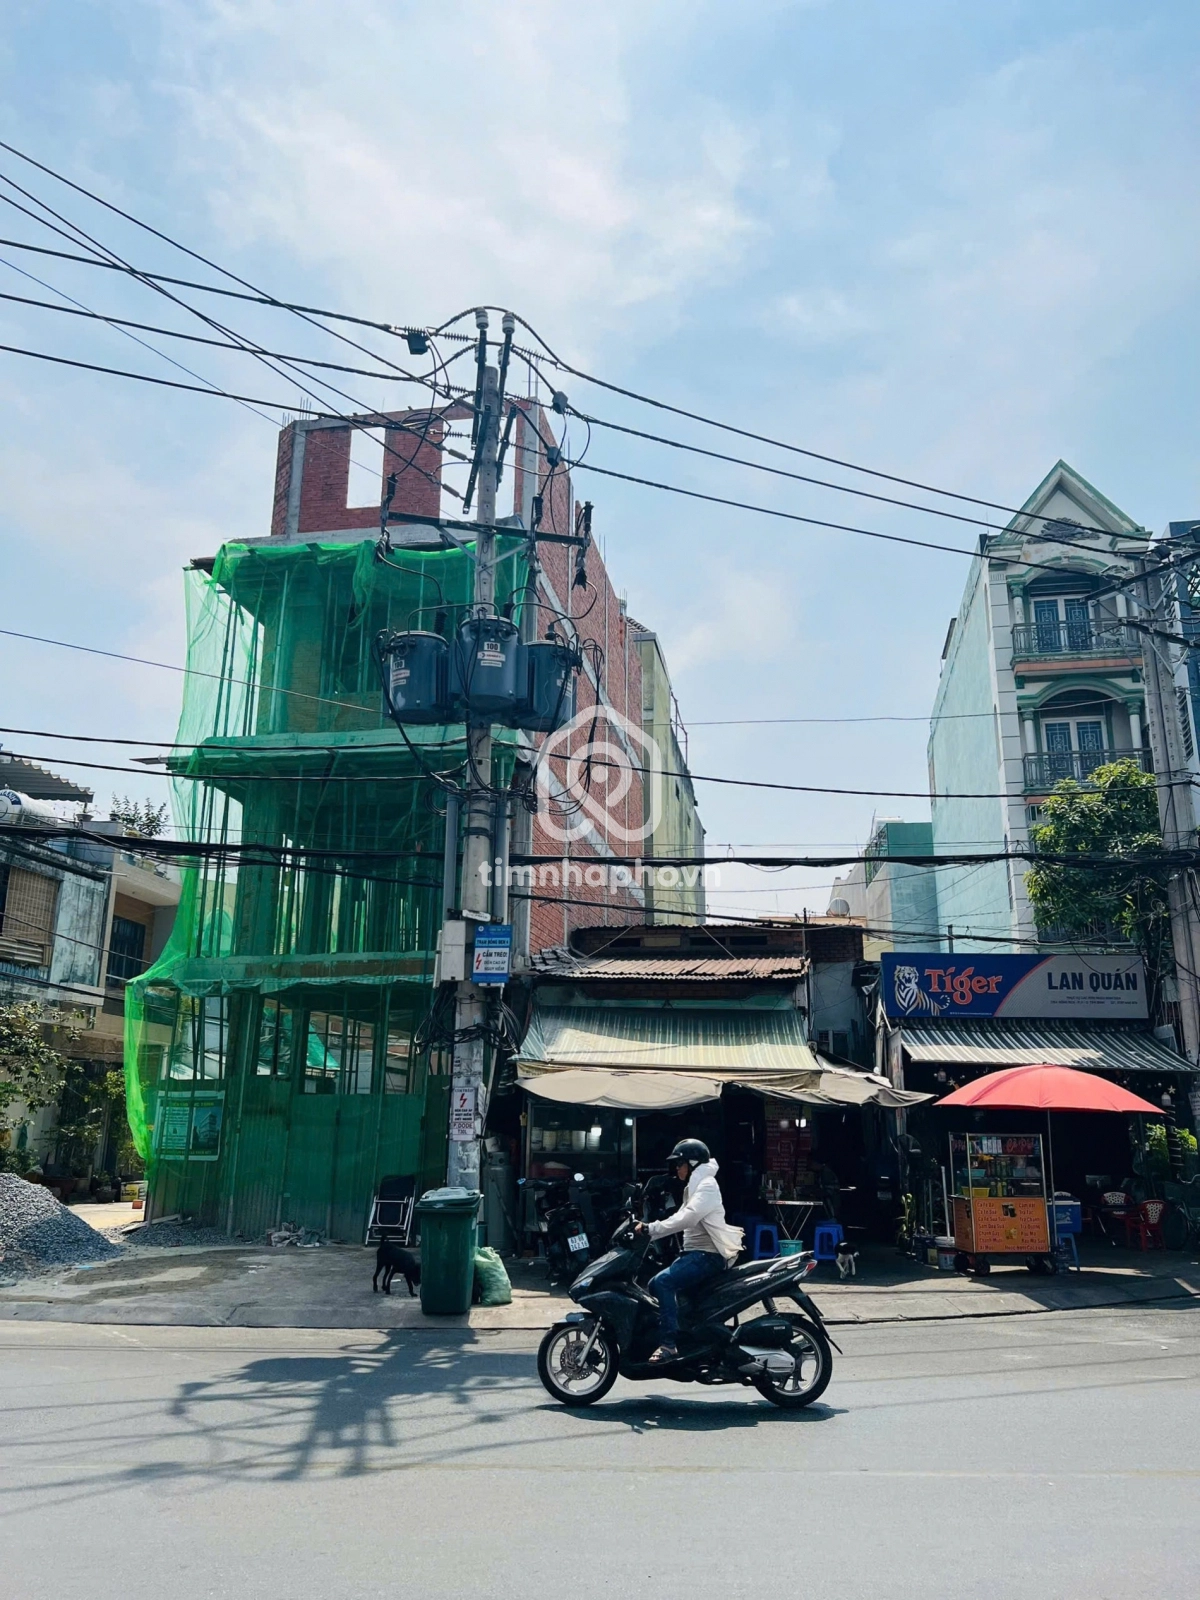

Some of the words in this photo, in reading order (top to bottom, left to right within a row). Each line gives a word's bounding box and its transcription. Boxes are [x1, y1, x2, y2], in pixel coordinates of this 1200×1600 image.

[486, 642, 499, 651] 100
[924, 966, 1003, 1005] Tiger
[1047, 972, 1084, 991] LAN
[1089, 968, 1138, 993] QUÁN
